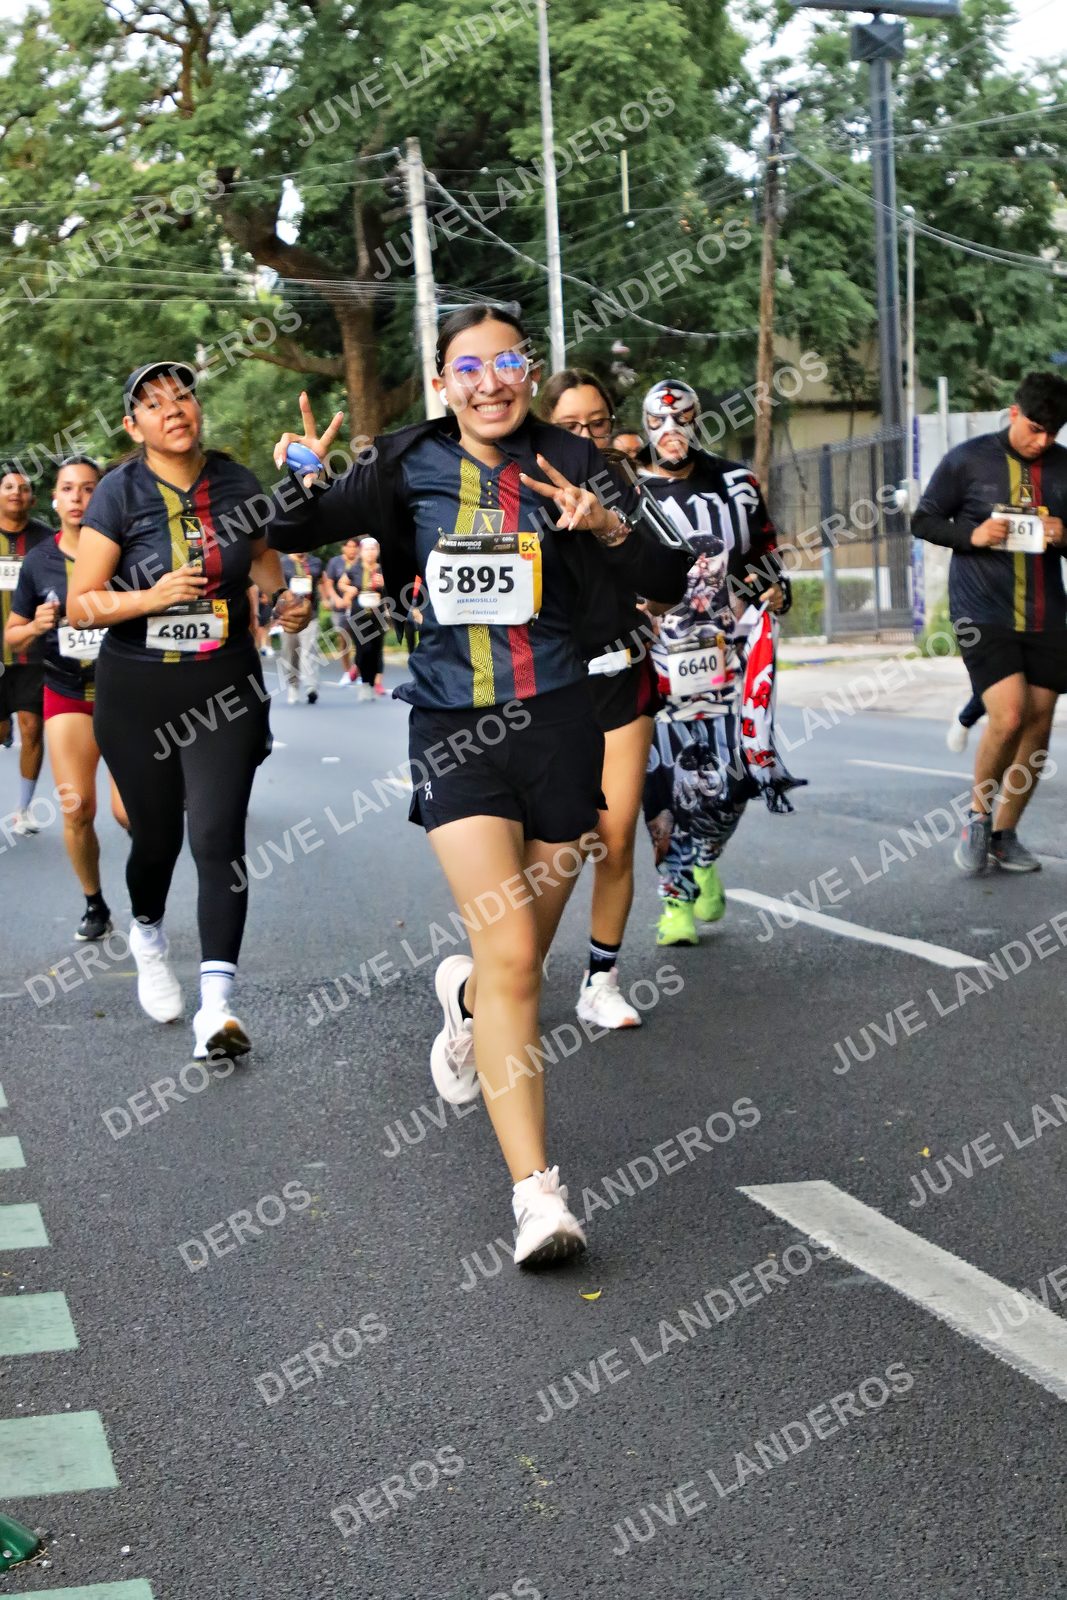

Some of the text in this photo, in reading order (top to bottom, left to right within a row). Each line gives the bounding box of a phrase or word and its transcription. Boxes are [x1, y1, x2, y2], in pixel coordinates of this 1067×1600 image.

[521, 541, 535, 552] 5K
[438, 566, 514, 594] 5895
[158, 622, 210, 640] 6803
[678, 654, 717, 677] 6640
